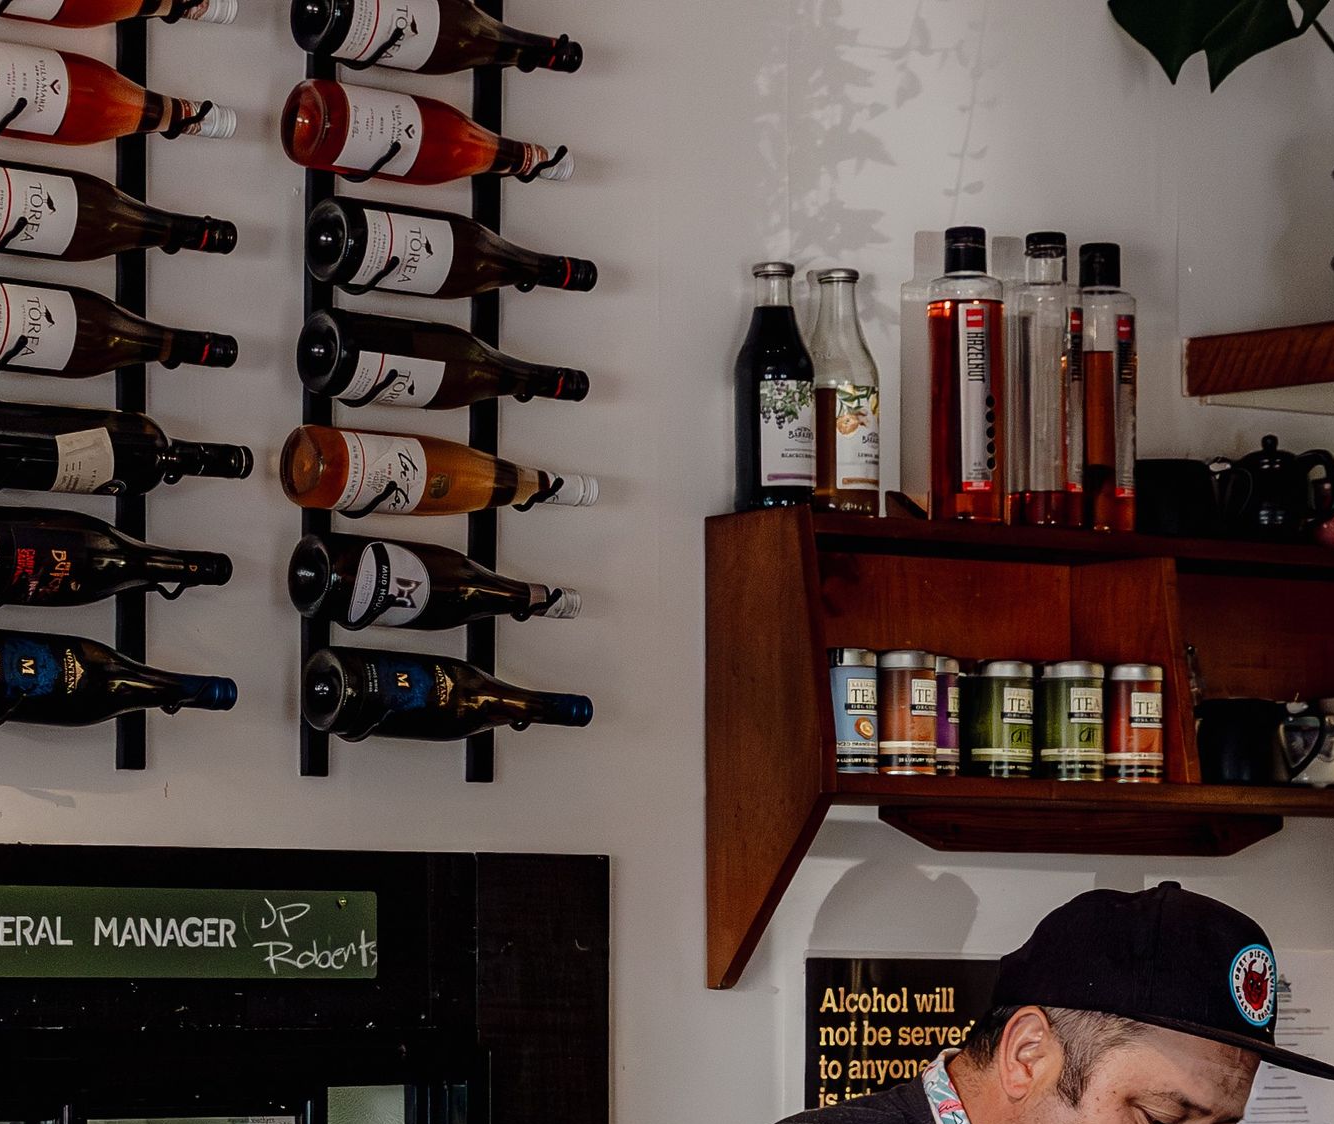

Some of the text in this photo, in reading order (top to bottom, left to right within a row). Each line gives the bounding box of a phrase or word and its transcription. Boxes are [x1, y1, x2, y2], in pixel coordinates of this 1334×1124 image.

[20, 183, 43, 242] TOREA
[397, 227, 421, 283] TOREA
[966, 331, 986, 383] HAZELNUT
[94, 917, 237, 948] MANAGER
[819, 987, 956, 1013] Alcohol will
[819, 1021, 858, 1047] not
[863, 1020, 892, 1047] be
[819, 1054, 843, 1080] to
